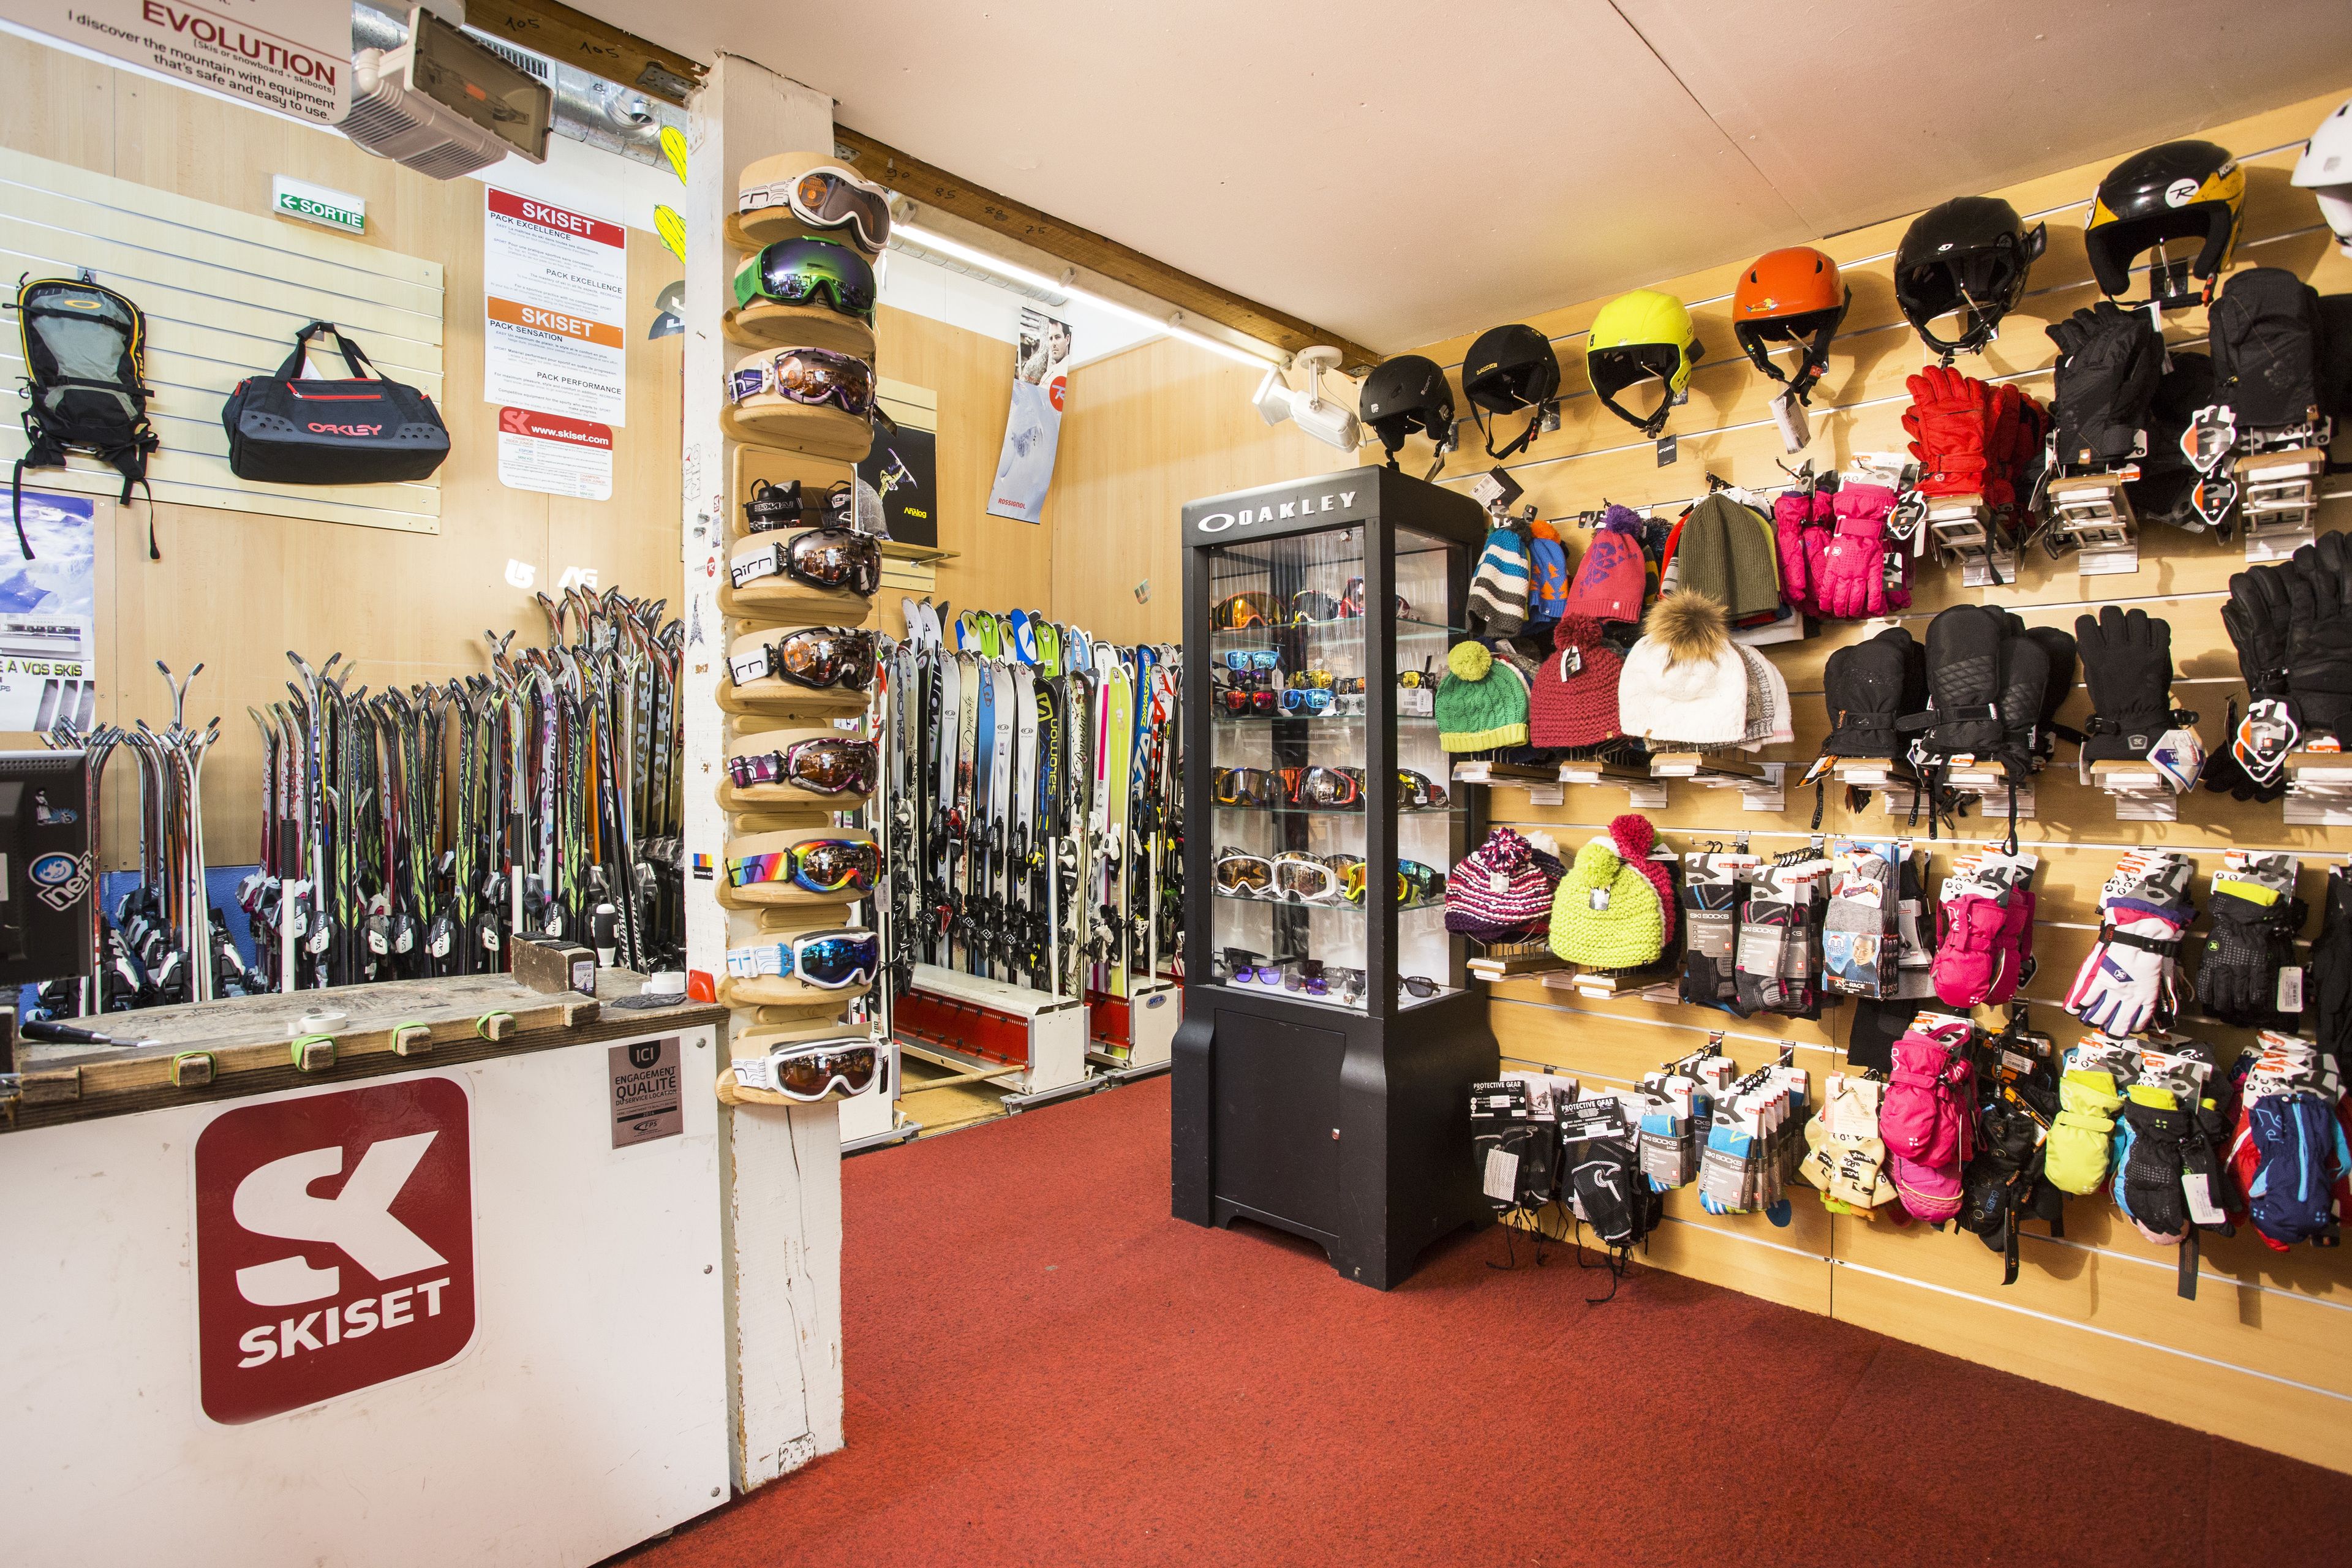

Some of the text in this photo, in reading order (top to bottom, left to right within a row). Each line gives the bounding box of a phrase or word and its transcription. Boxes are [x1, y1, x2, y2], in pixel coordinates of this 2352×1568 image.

[143, 0, 335, 86] EVOLUTION
[68, 9, 335, 111] I discover the mountain with equipment
[221, 48, 230, 58] or
[233, 53, 284, 77] snowboard
[154, 55, 330, 121] that's safe and easy to use.
[300, 200, 362, 228] SORTIE
[490, 212, 571, 241] PACK EXCELLENCE
[522, 202, 595, 236] SKISET
[546, 268, 568, 281] PACK
[570, 274, 622, 294] EXCELLENCE
[490, 320, 563, 342] PACK SENSATION
[521, 307, 594, 337] SKISET
[537, 371, 559, 382] PACK
[561, 377, 622, 395] PERFORMANCE
[307, 422, 382, 437] OAKLEY
[531, 425, 609, 445] www.skiset.com
[998, 497, 1026, 510] ROSSIGNOL
[1238, 491, 1357, 527] OAKLEY
[22, 661, 50, 676] VOS
[54, 663, 83, 677] SKIS
[1140, 665, 1151, 728] DYNASTAR
[47, 856, 92, 906] neff
[1752, 926, 1779, 935] SOCKS
[636, 1047, 654, 1063] ICI
[615, 1066, 676, 1085] ENGAGEMENT
[616, 1074, 676, 1101] QUALITÉ
[625, 1094, 648, 1105] SERVICE
[649, 1088, 677, 1099] LOCATION
[1561, 1098, 1614, 1112] PROTECTIVE GEAR
[1652, 1136, 1678, 1147] SOCKS
[1705, 1150, 1742, 1167] SKI SOCKS
[237, 1277, 450, 1369] SKISET
